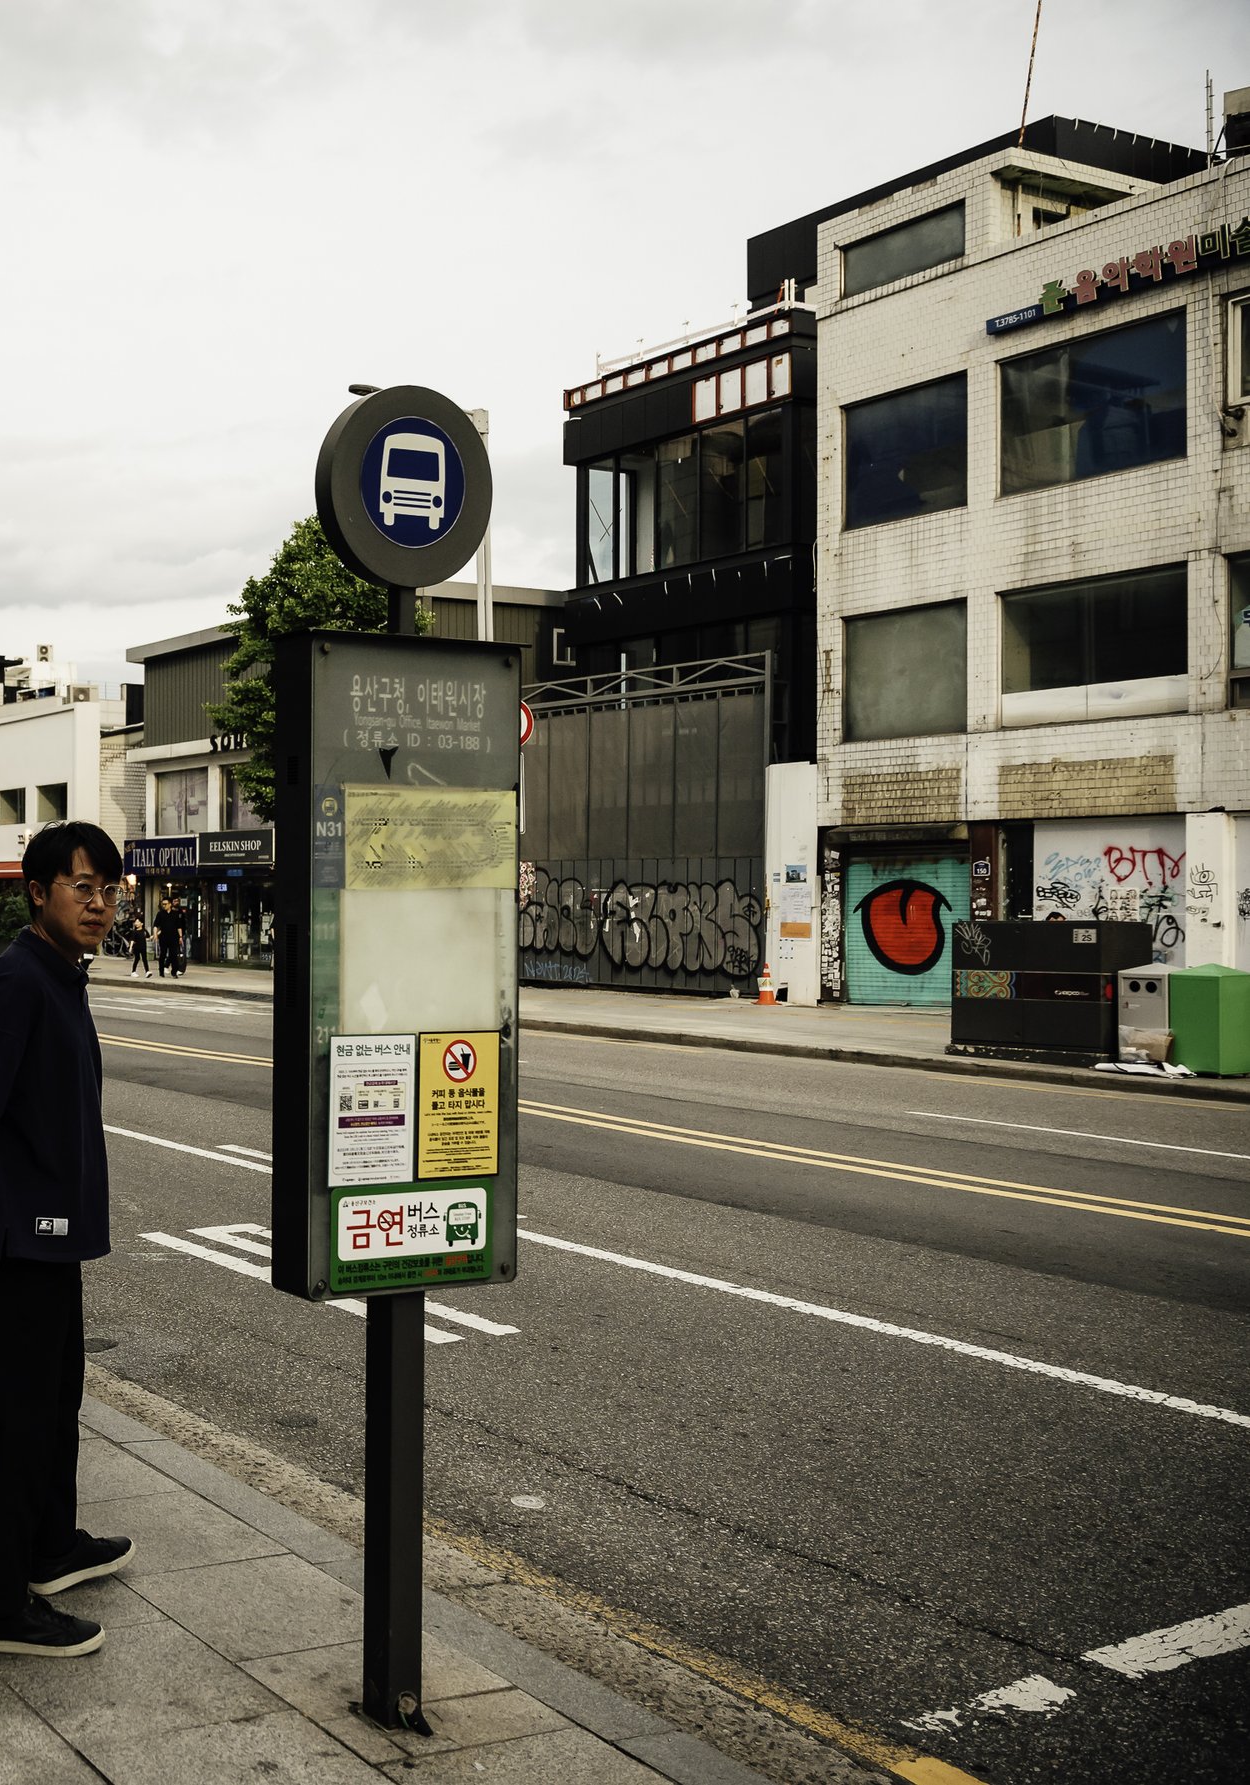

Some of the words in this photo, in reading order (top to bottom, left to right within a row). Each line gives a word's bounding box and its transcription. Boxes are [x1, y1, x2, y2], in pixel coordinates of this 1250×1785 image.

[417, 678, 487, 719] 이태원시장
[353, 712, 397, 731] Yongsan-gu
[426, 715, 454, 731] Itaewon
[456, 716, 482, 733] Market
[209, 733, 248, 754] SOH
[356, 730, 399, 748] 정류소
[406, 733, 421, 748] ID
[438, 734, 481, 751] 03-188
[316, 820, 343, 837] N31
[209, 841, 240, 852] EELSKIN
[240, 840, 262, 851] SHOP
[132, 848, 156, 868] ITALY
[158, 846, 195, 867] OPTICAL
[336, 1044, 354, 1057] 현금
[356, 1044, 372, 1057] 없는
[375, 1044, 392, 1056] 버스
[394, 1043, 411, 1056] 안내
[431, 1089, 446, 1099] 커피
[448, 1088, 456, 1098] 등
[458, 1087, 485, 1098] 음식물을
[448, 1100, 463, 1110] 타지
[346, 1206, 404, 1249] 금연
[407, 1201, 440, 1223] 버스
[407, 1223, 440, 1239] 정류소
